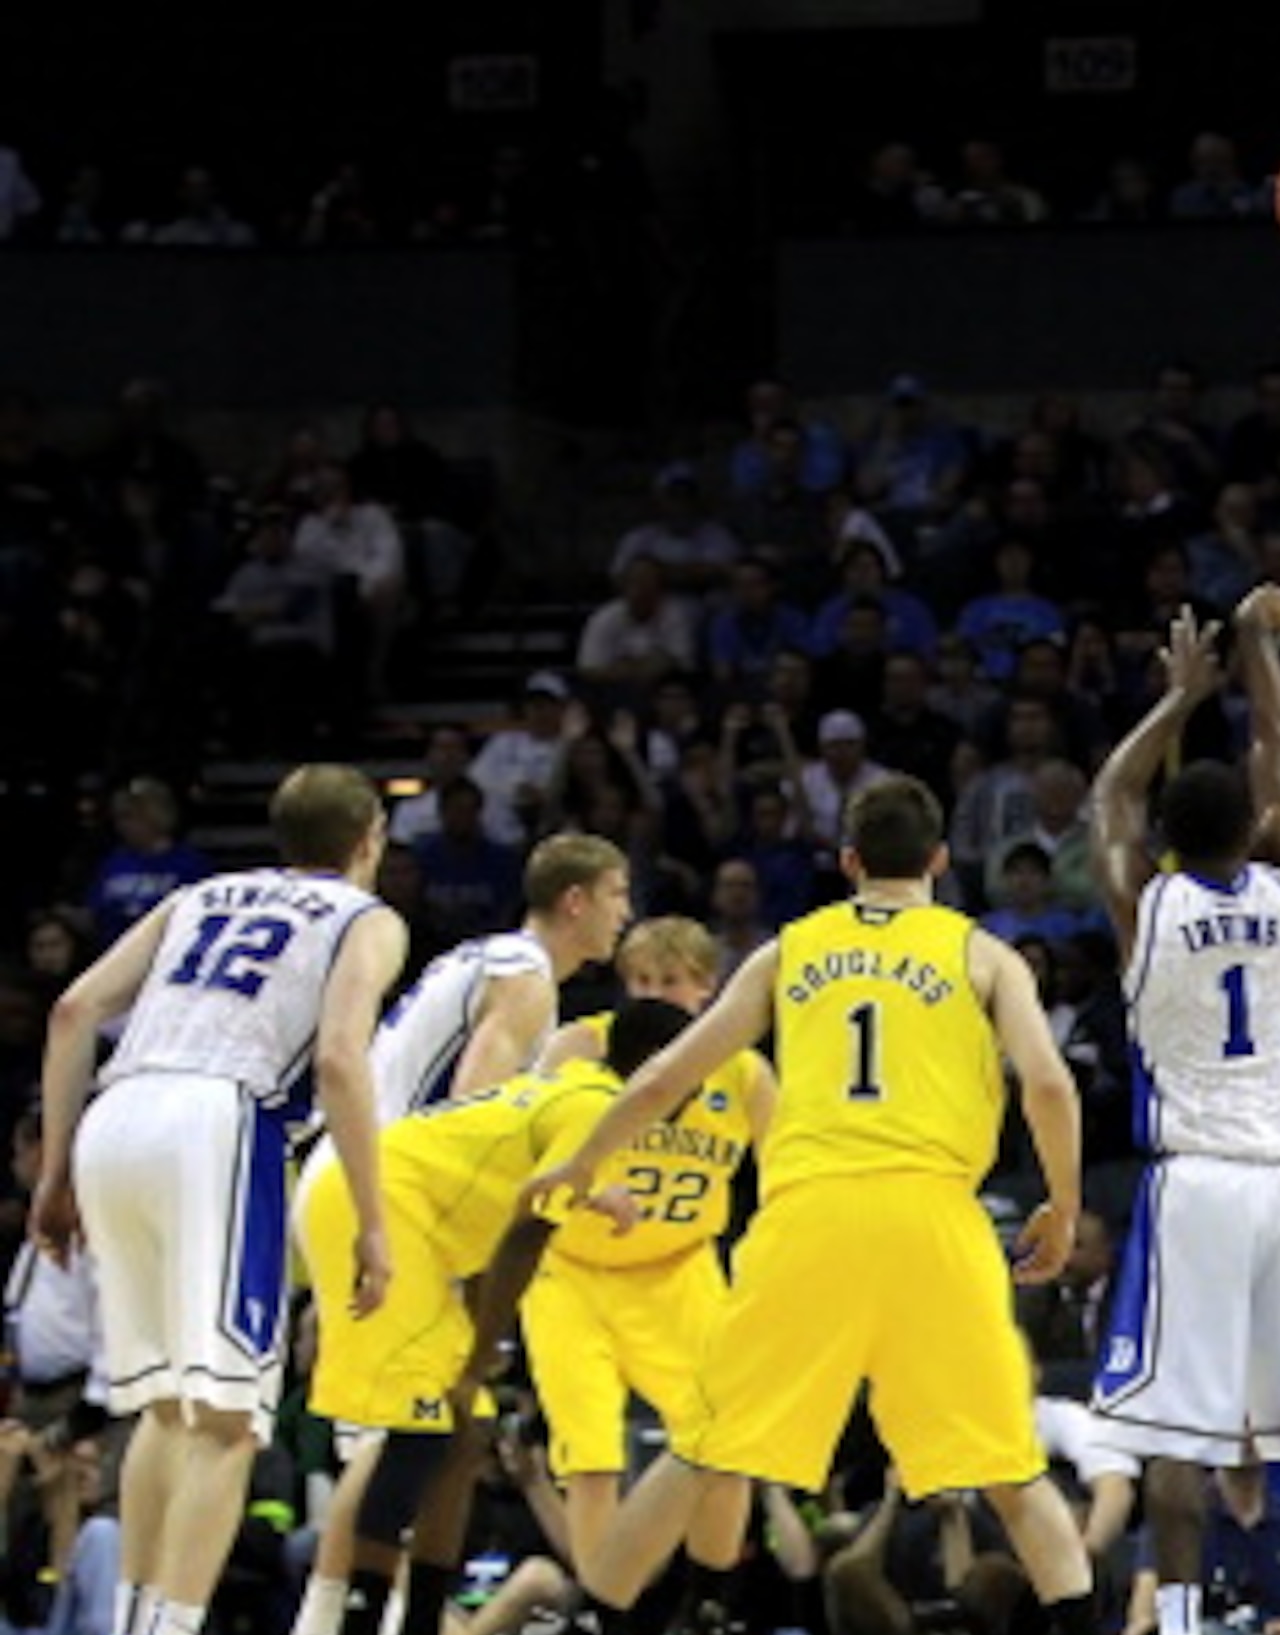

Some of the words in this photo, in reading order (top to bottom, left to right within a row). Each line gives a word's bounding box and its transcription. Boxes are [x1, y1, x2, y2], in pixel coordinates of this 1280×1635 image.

[168, 914, 294, 998] 12
[847, 1002, 883, 1101] 1
[1221, 963, 1256, 1060] 1
[627, 1166, 710, 1222] 22
